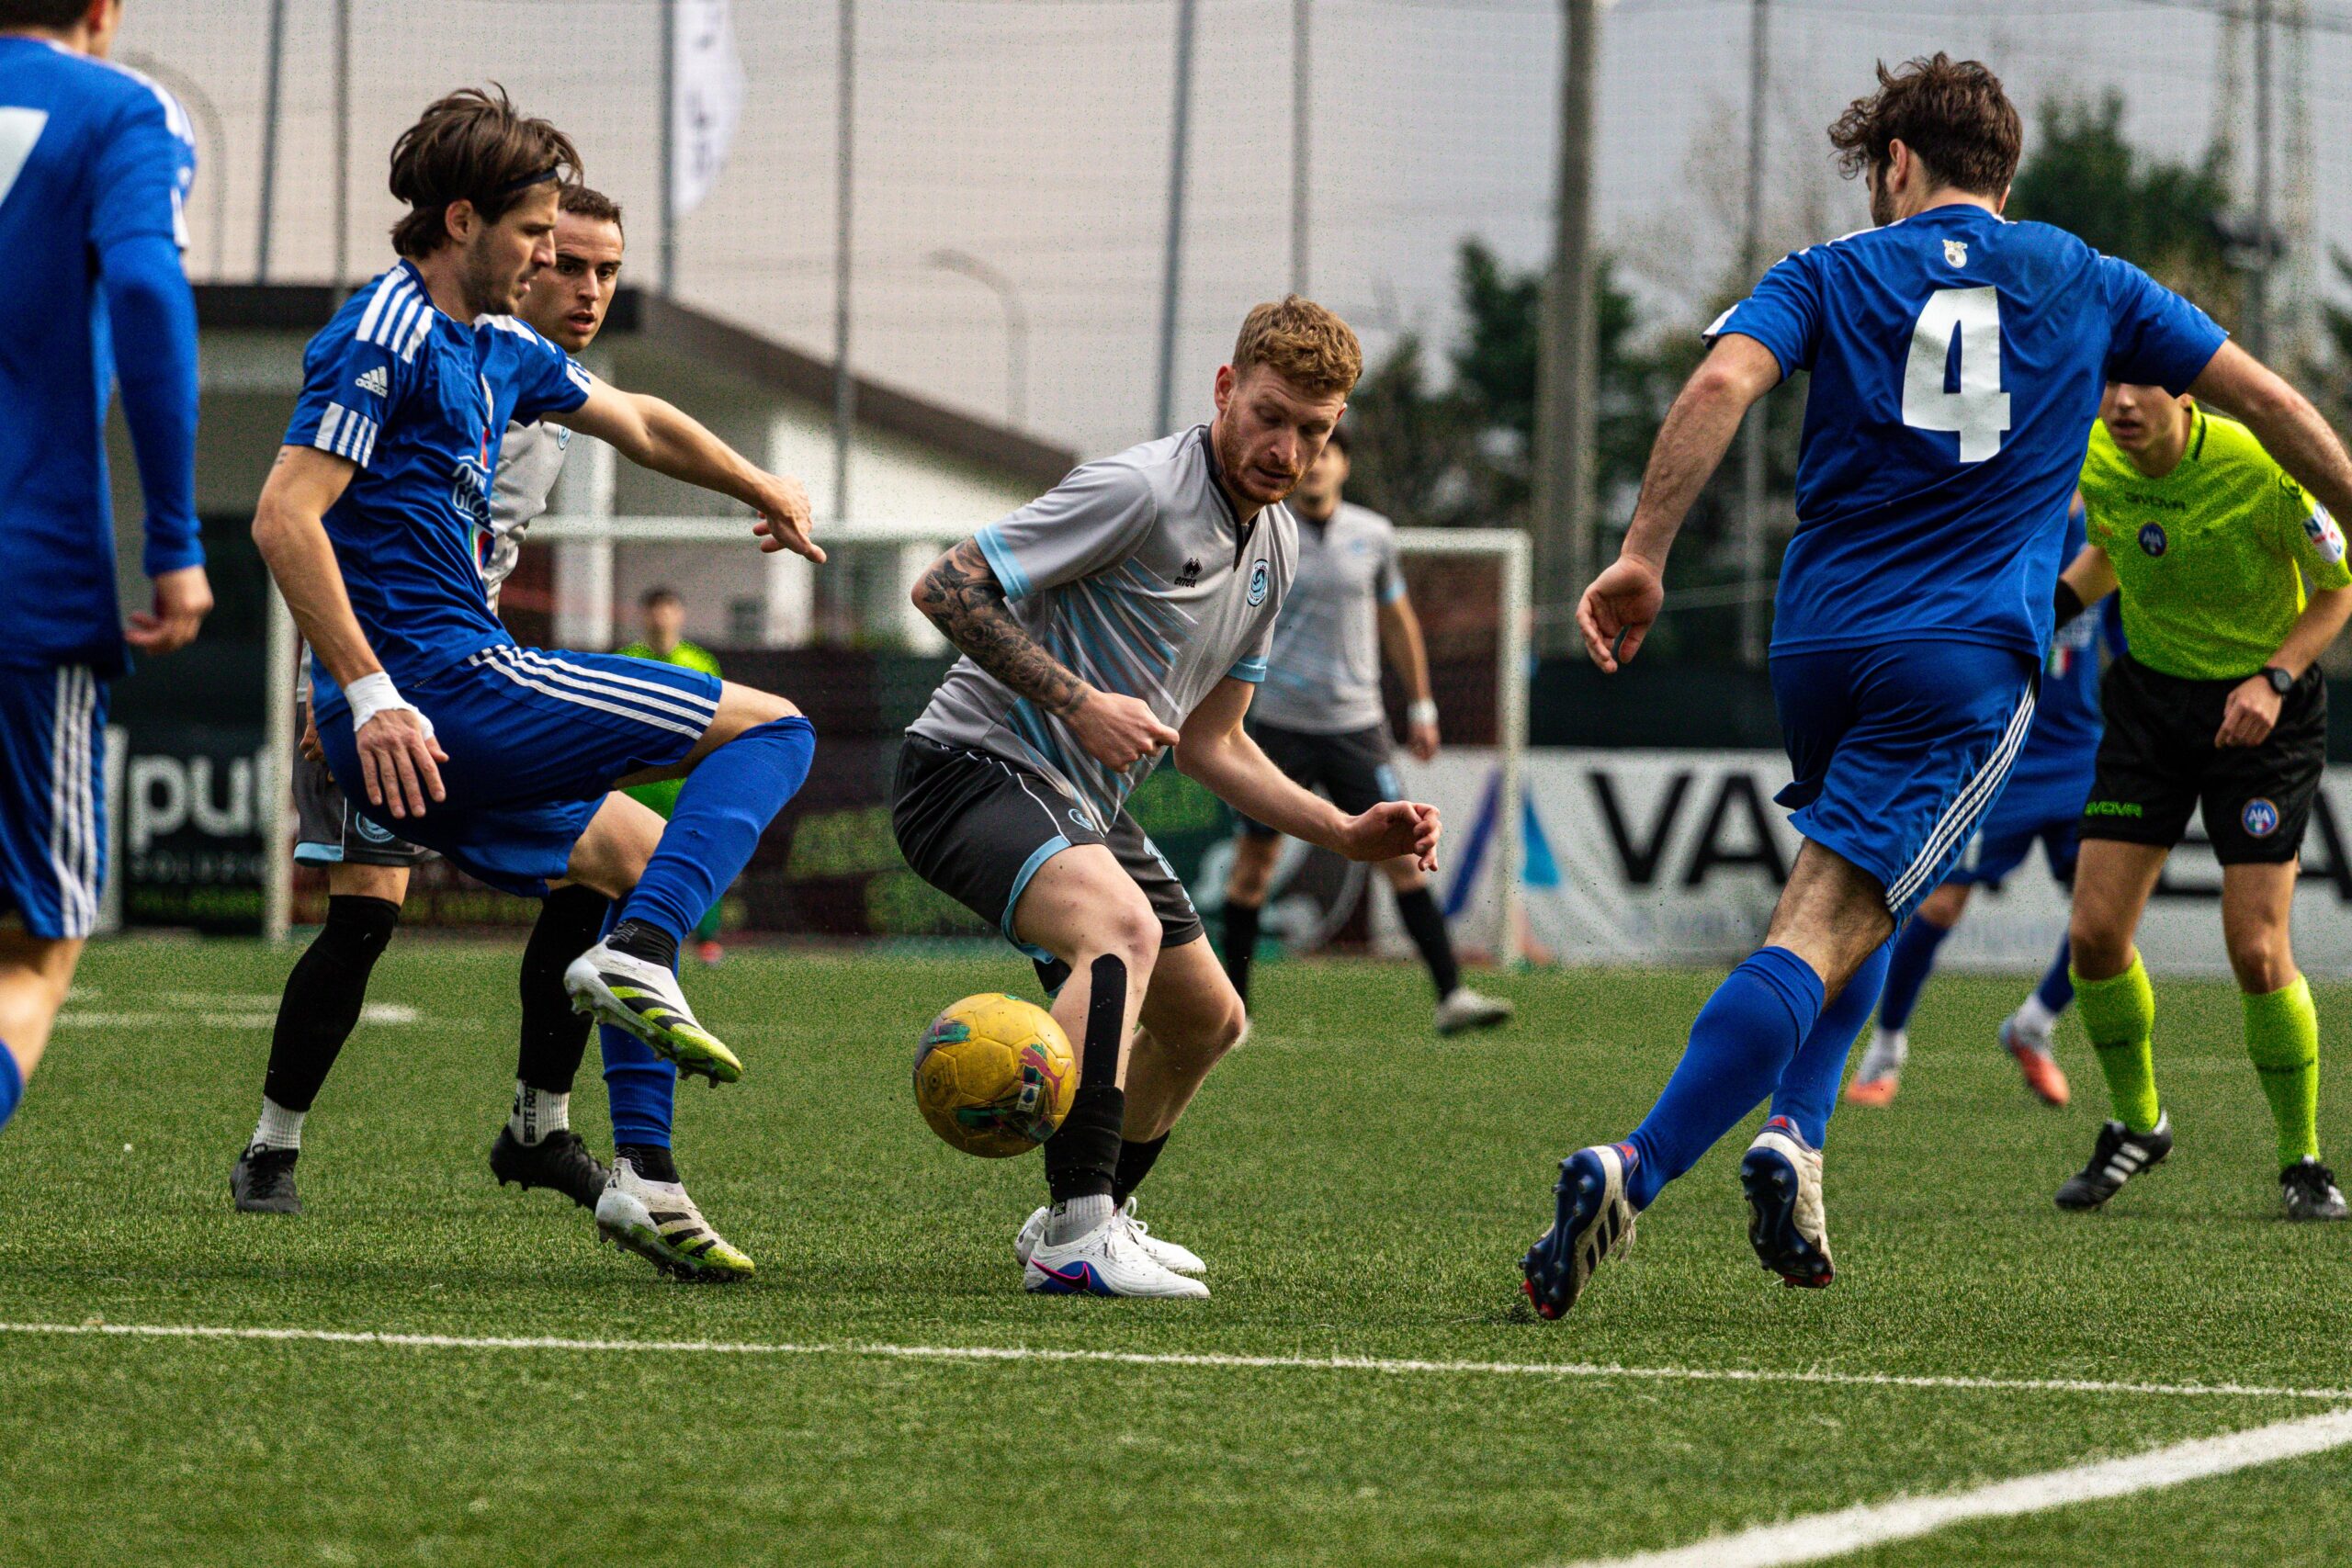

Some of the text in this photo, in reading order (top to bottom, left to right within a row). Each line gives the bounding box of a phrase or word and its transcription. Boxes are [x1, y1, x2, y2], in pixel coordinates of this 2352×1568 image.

[1902, 285, 2011, 463] 4
[355, 377, 388, 398] adidas
[2248, 807, 2271, 824] AIA
